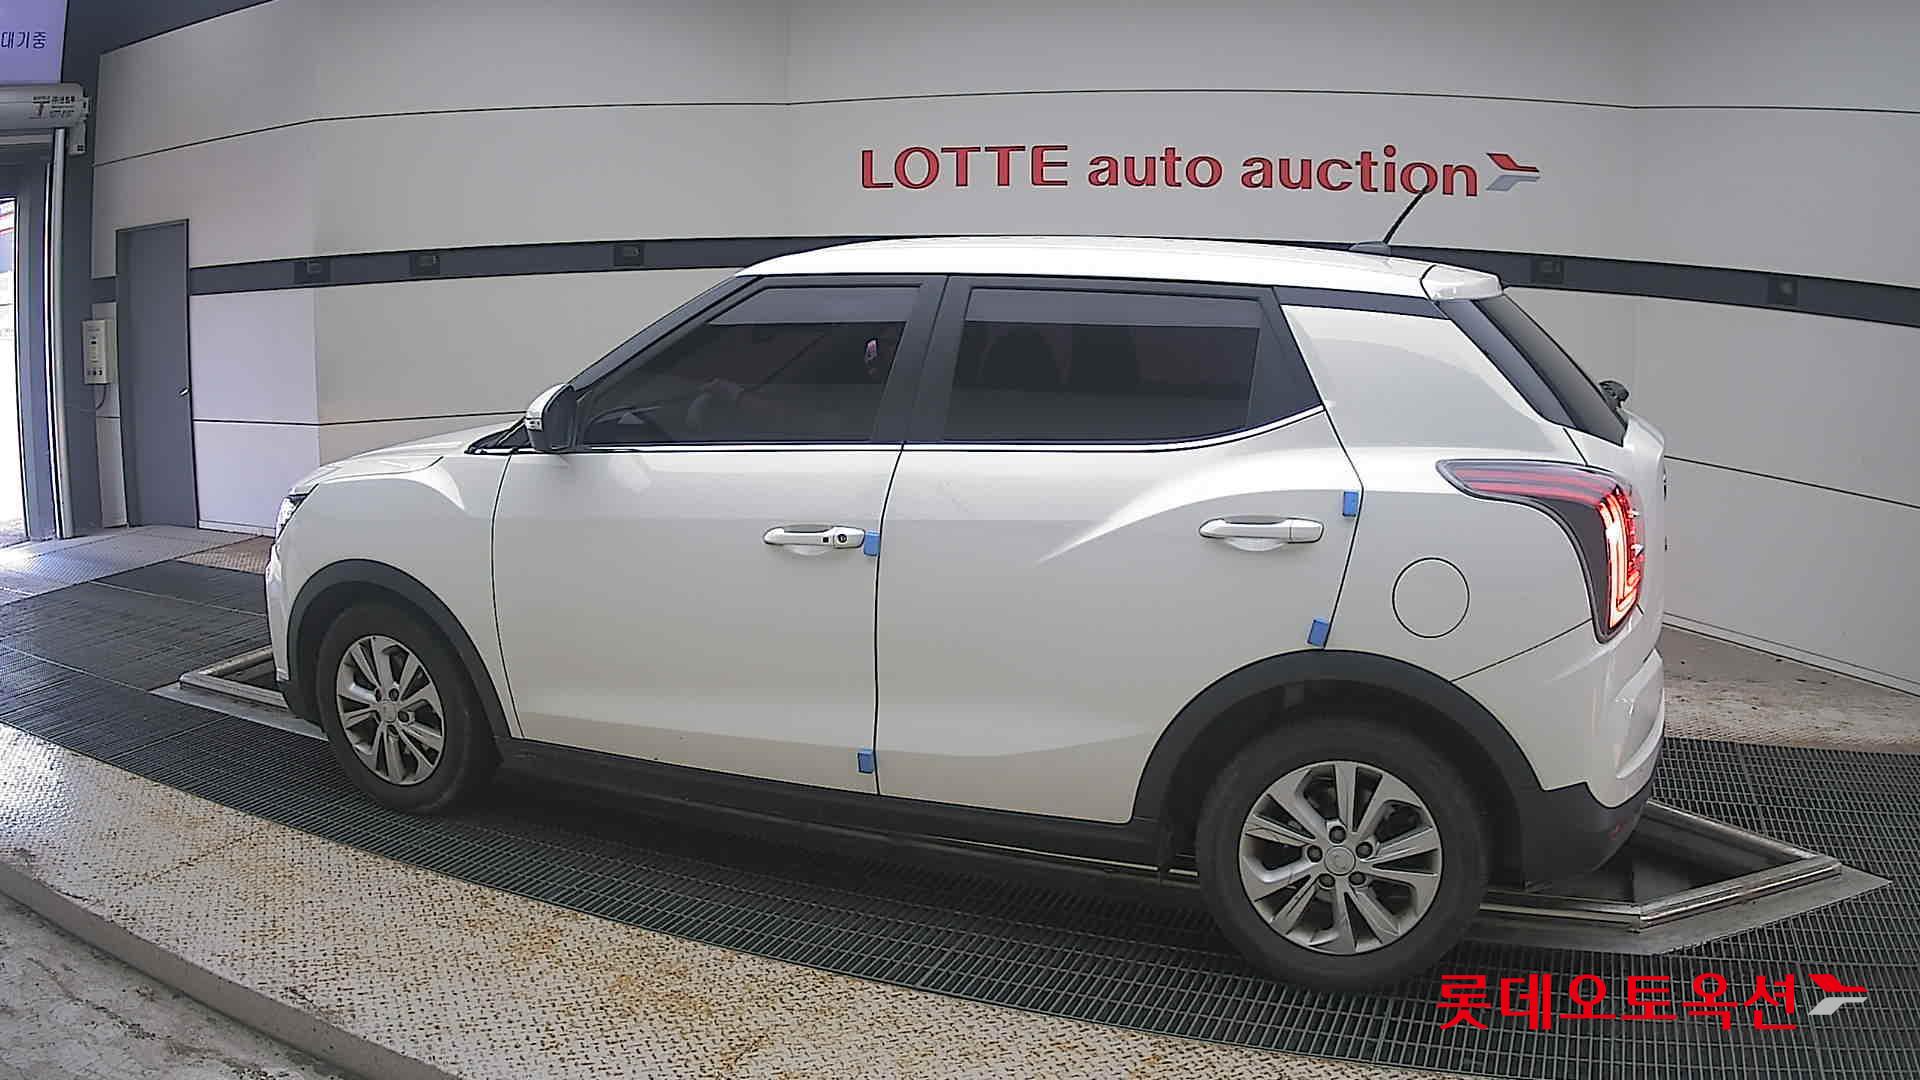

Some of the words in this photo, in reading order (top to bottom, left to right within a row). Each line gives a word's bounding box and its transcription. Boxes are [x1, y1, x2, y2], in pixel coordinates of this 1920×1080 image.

[1, 31, 48, 49] 대기중
[861, 145, 1069, 189] LOTTE
[1087, 146, 1223, 188] auto
[1240, 144, 1478, 197] auction
